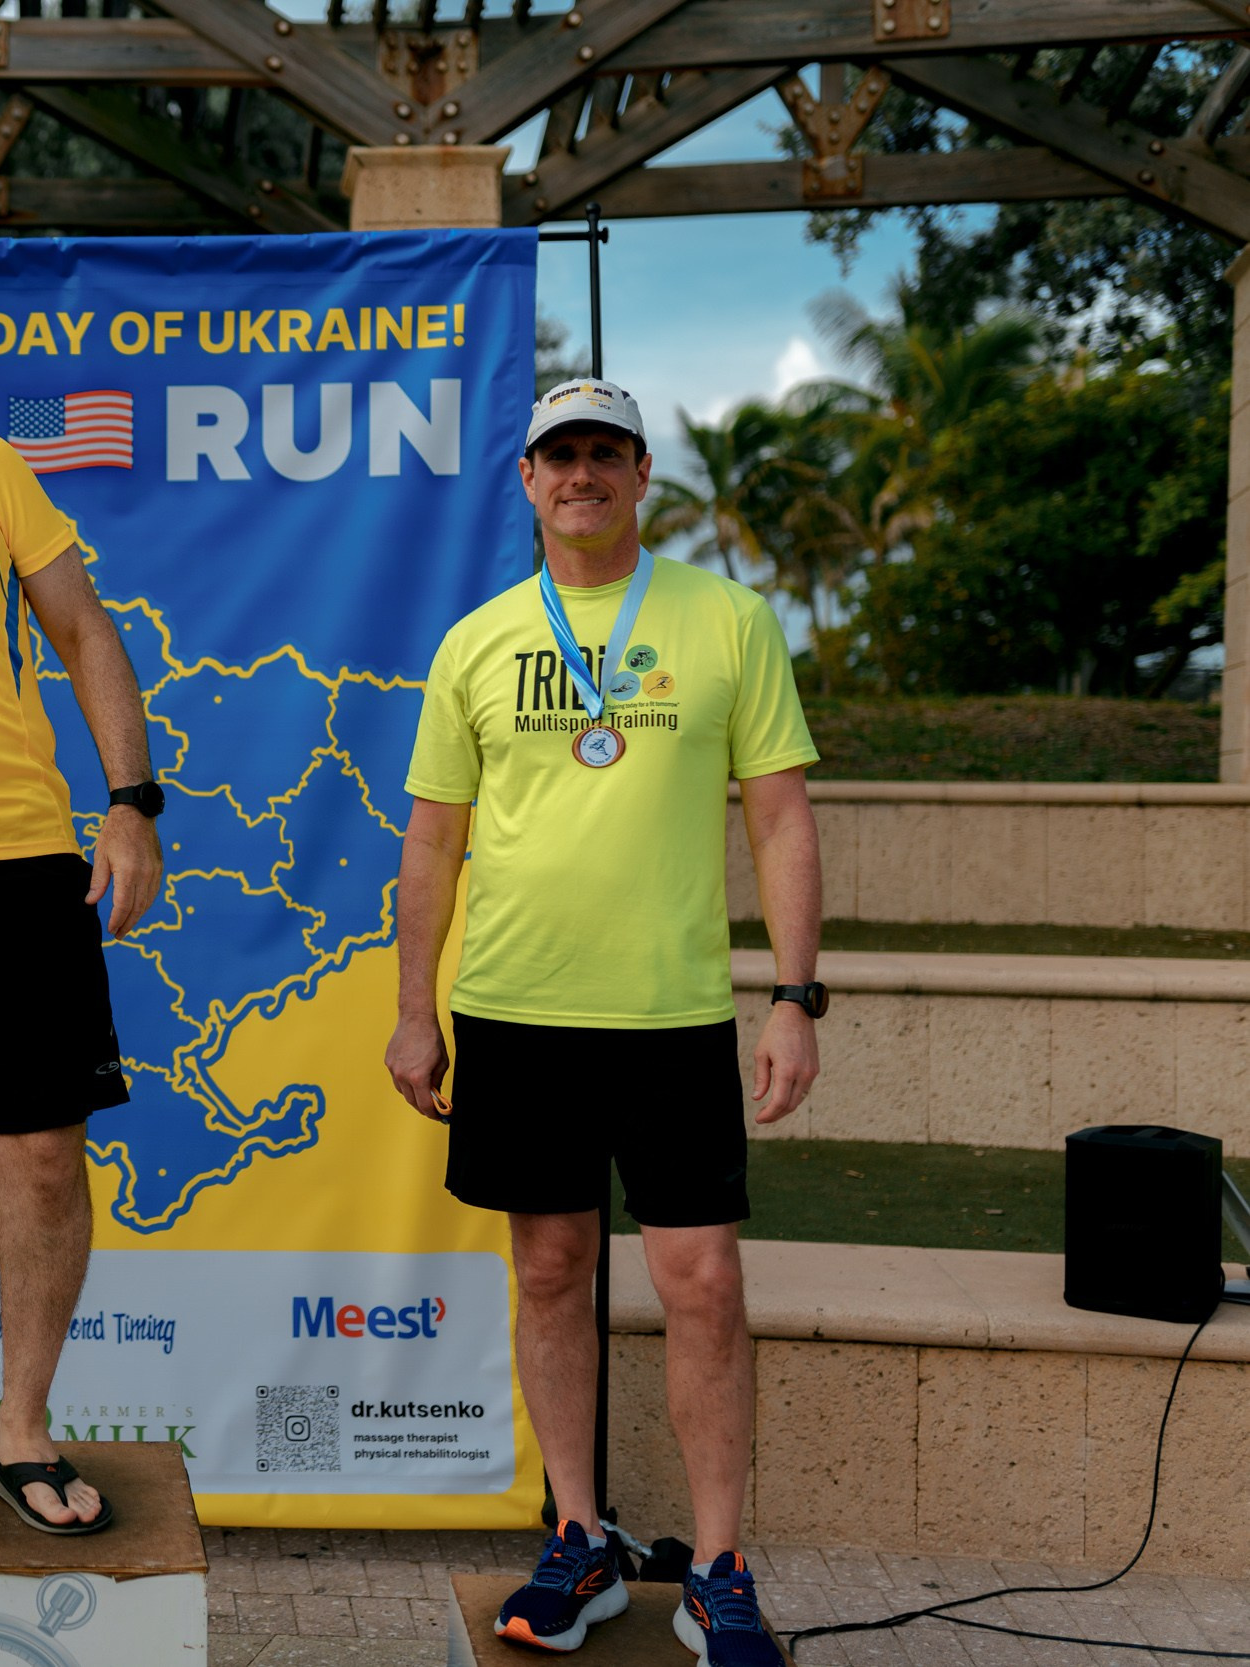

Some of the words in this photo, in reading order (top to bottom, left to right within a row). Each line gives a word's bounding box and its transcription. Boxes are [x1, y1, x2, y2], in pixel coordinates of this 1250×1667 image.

[110, 311, 183, 354] OF
[199, 304, 466, 353] UKRAINE!
[166, 378, 461, 483] RUN
[608, 710, 678, 731] Training
[292, 1296, 438, 1339] Meest
[113, 1313, 176, 1354] Timing
[351, 1400, 485, 1418] dr.kutsenko
[353, 1434, 404, 1445] massage
[406, 1432, 459, 1444] therapist
[354, 1449, 402, 1460] physical
[403, 1448, 490, 1460] rehabilitologist
